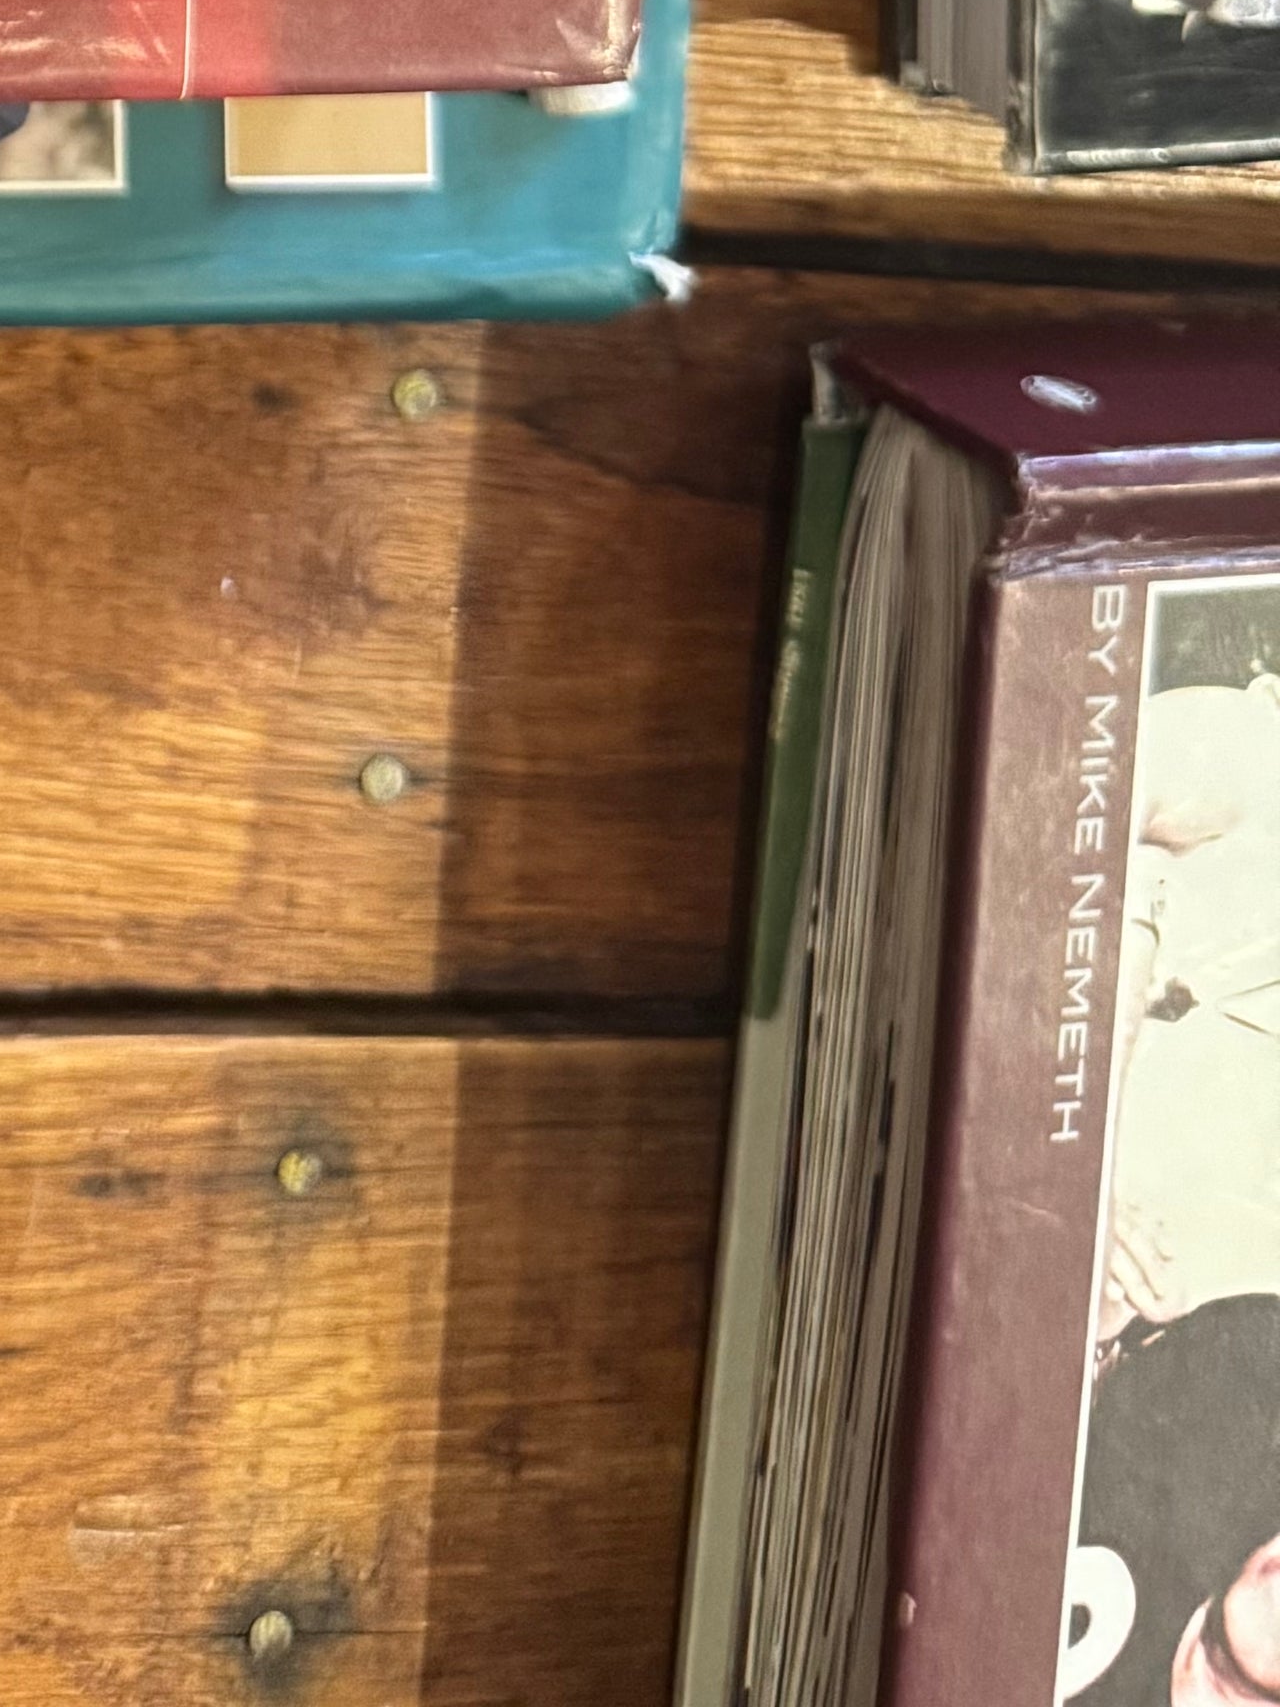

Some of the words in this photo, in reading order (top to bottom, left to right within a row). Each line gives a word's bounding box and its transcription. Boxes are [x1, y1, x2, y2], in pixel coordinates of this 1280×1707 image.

[1089, 585, 1124, 675] BY
[1072, 697, 1117, 852] MIKE
[1049, 874, 1102, 1142] NEMETH
